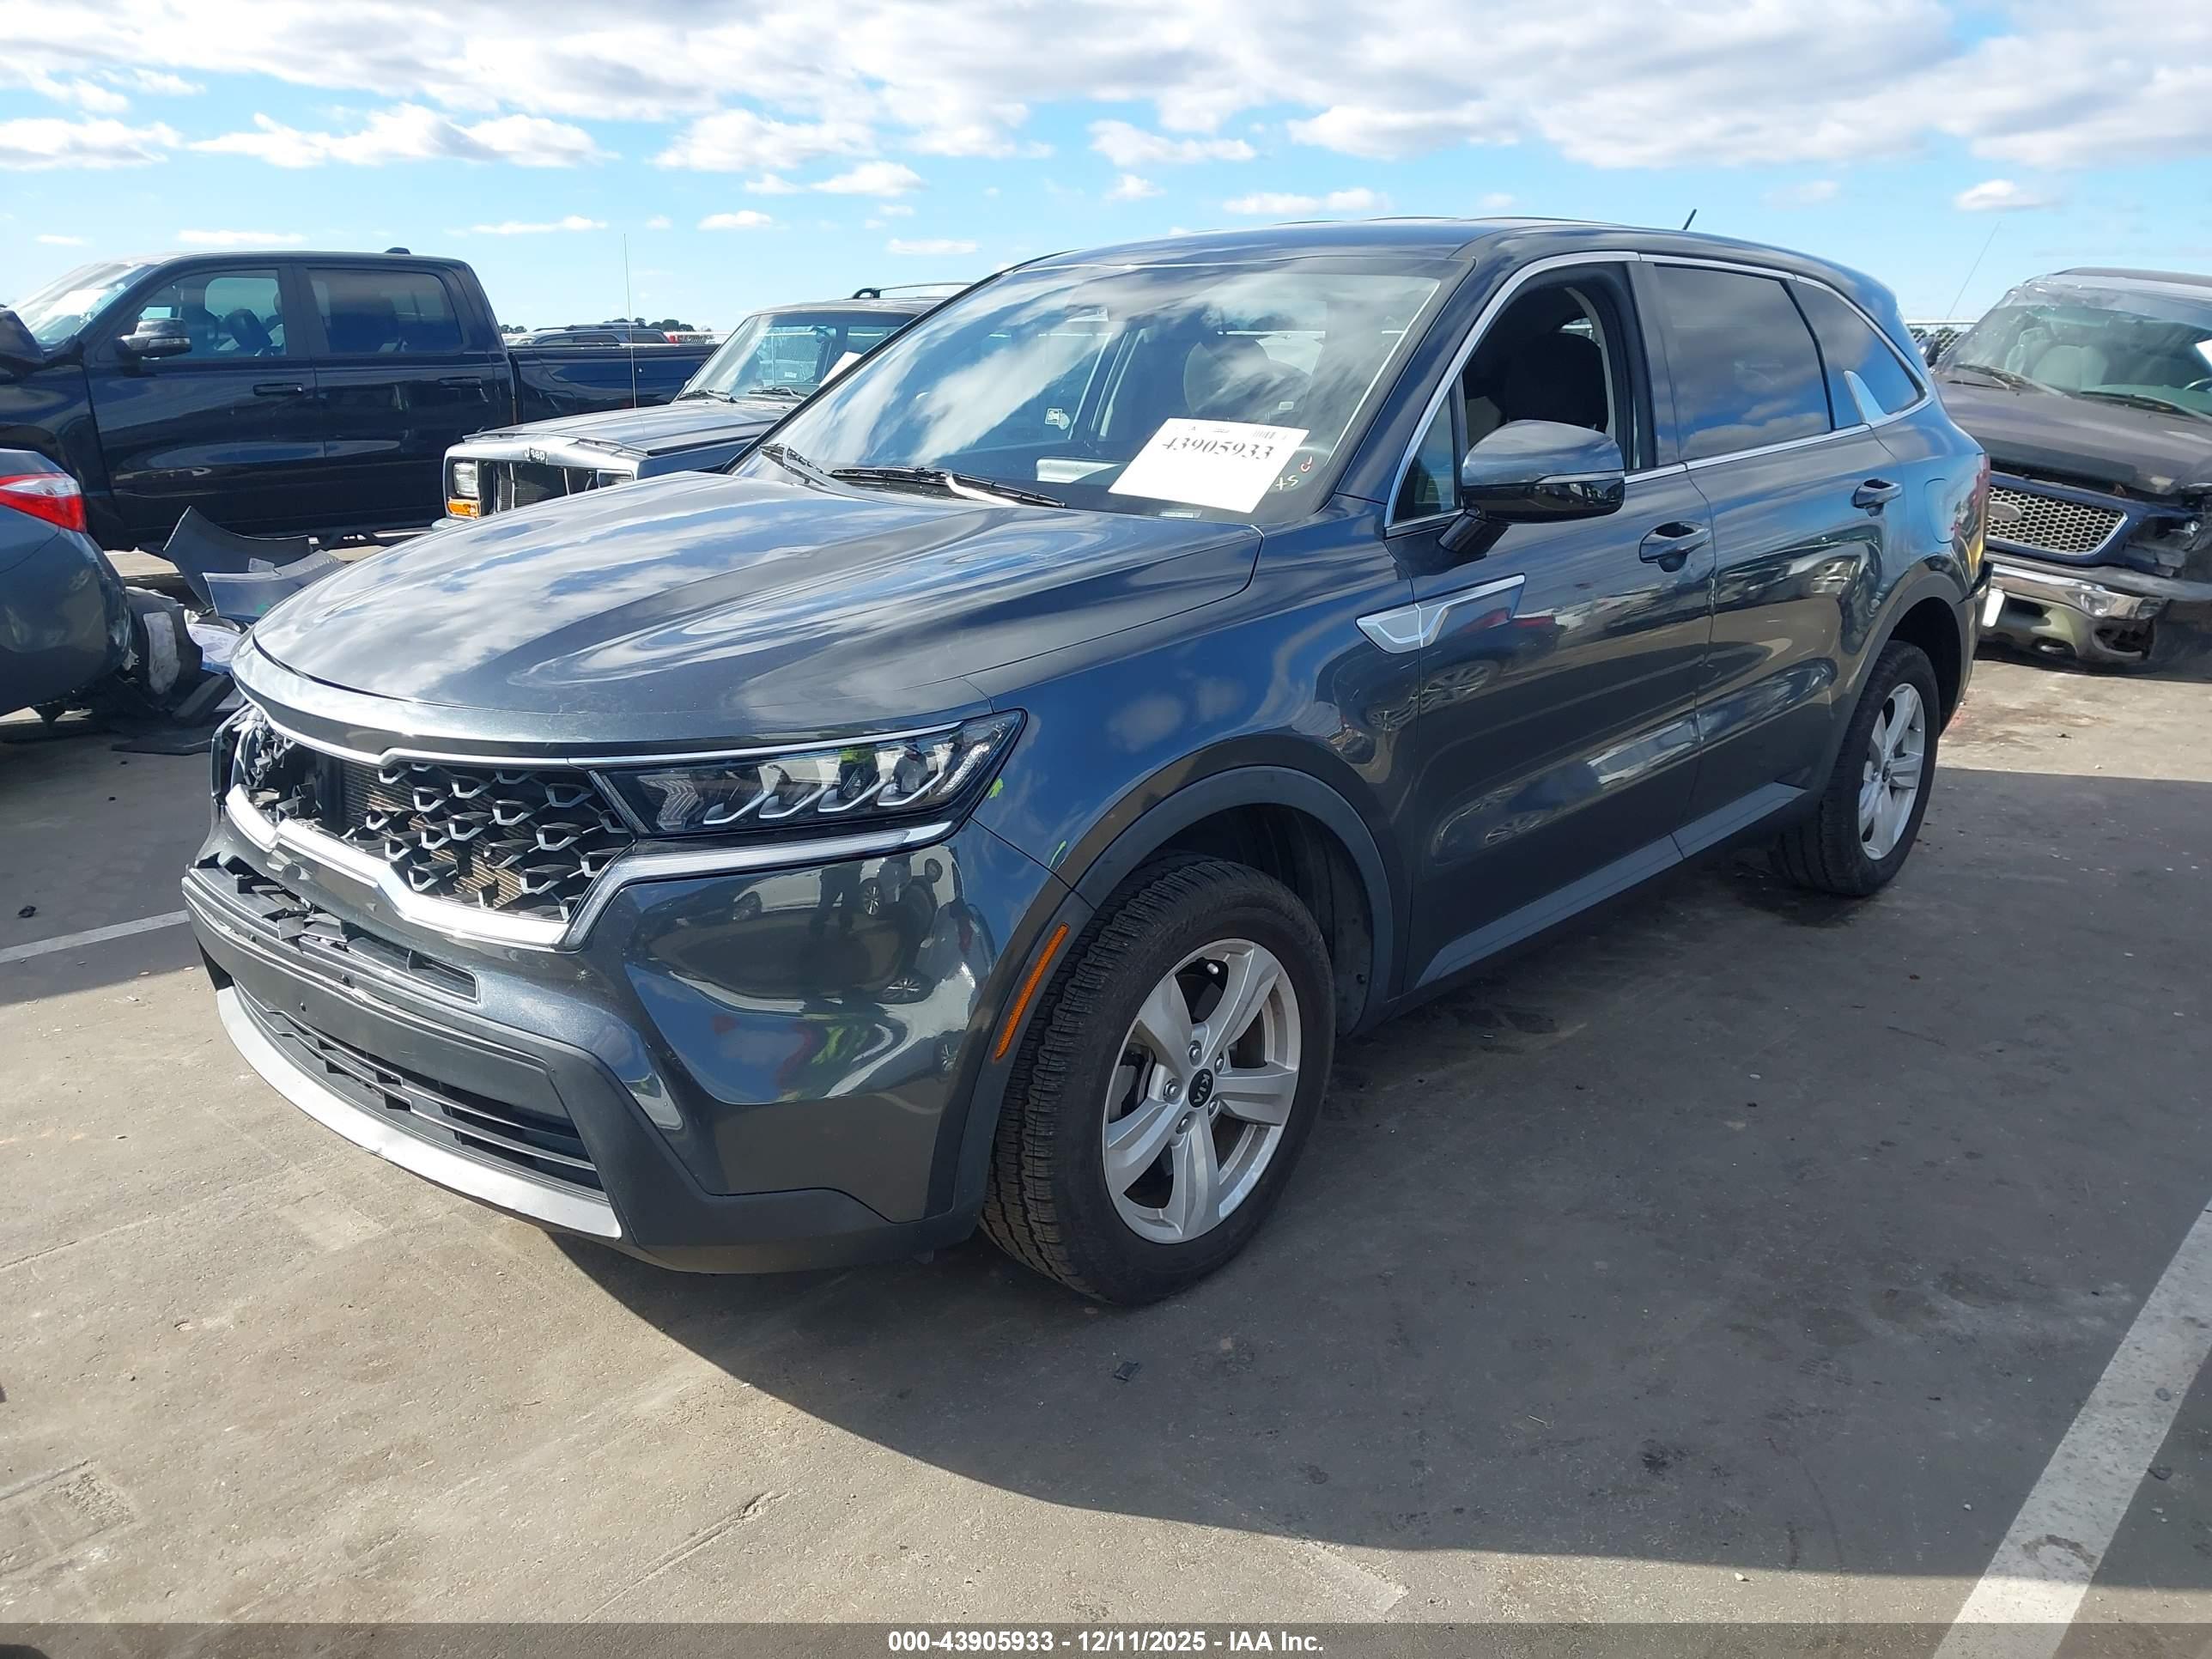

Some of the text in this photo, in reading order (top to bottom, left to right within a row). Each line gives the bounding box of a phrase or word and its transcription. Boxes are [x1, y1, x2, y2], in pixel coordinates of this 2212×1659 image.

[524, 447, 545, 461] Jeep
[1163, 437, 1274, 459] 43905933
[1194, 1073, 1210, 1103] KIA
